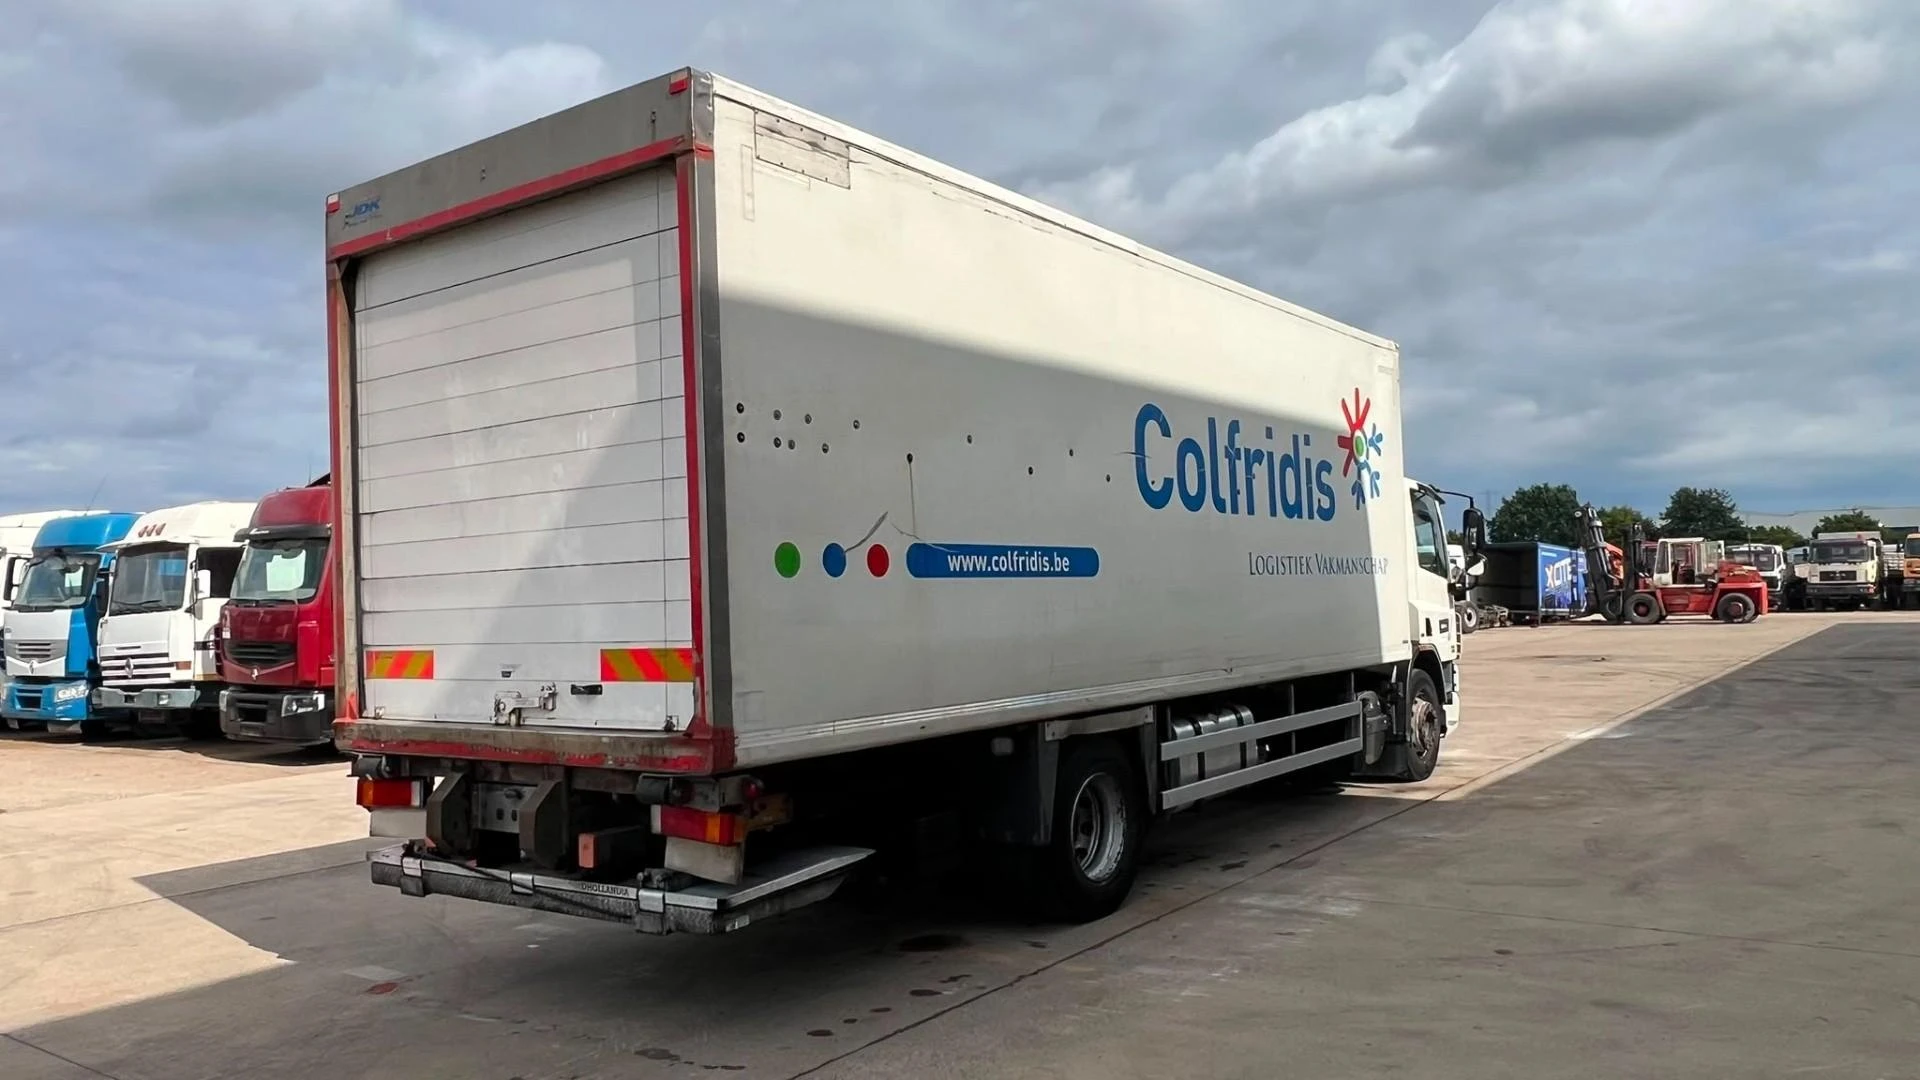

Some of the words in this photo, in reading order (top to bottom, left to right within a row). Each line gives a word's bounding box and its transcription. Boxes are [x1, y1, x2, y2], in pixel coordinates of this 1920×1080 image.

[1134, 403, 1336, 521] Colfridis
[948, 551, 1069, 572] www.colfridis.be
[1249, 552, 1313, 575] LOGISTIEK
[1315, 553, 1388, 575] VAKMANSCHAP
